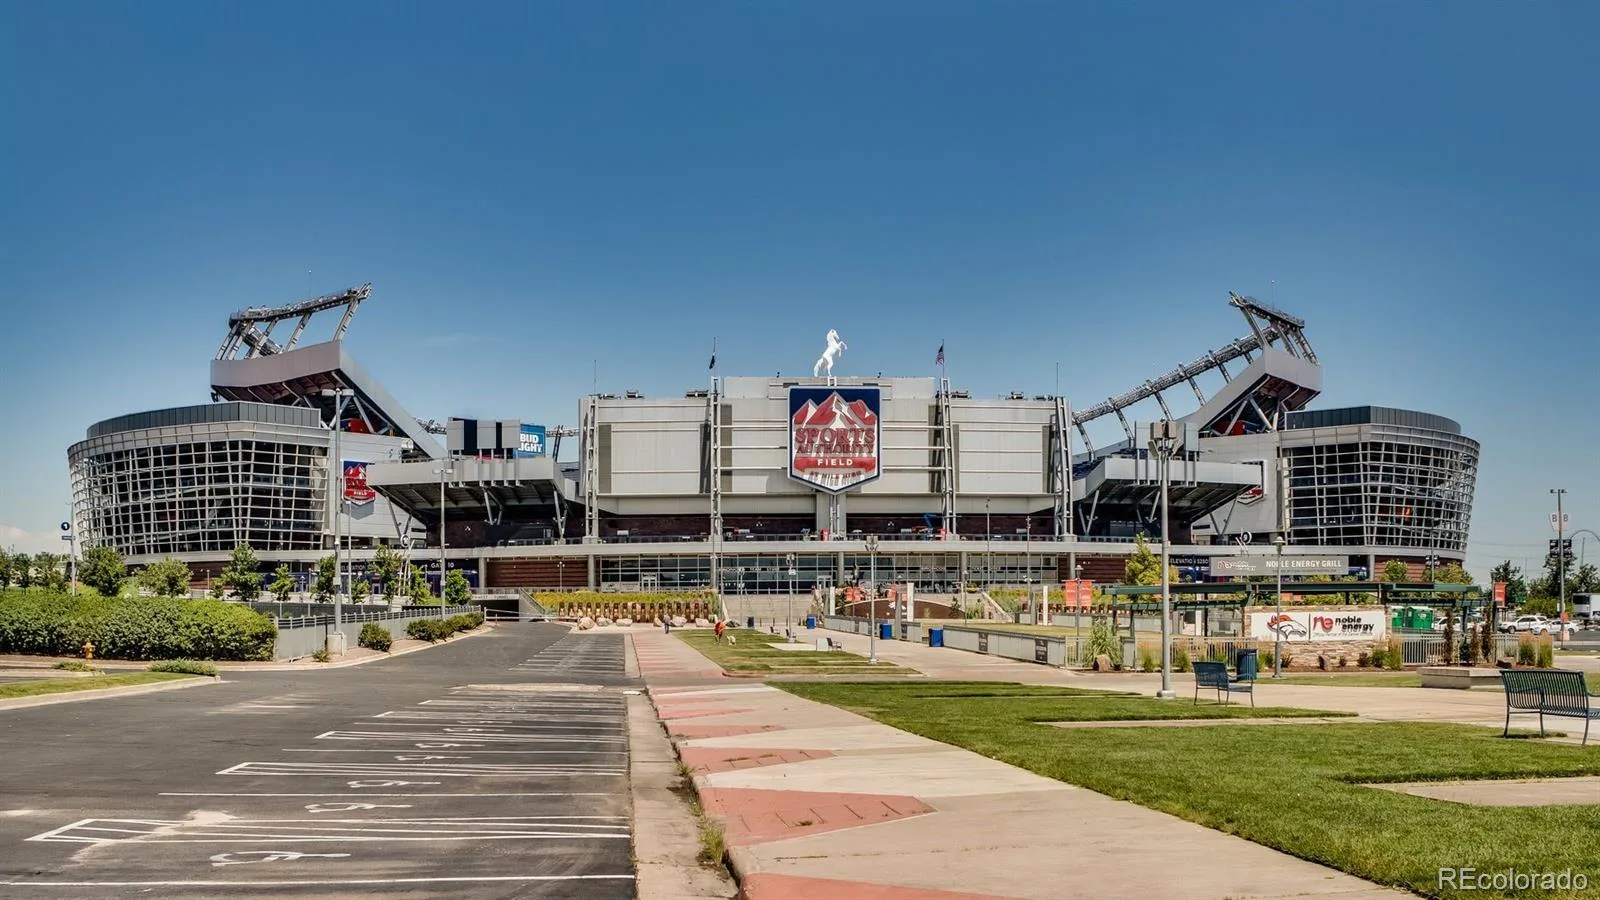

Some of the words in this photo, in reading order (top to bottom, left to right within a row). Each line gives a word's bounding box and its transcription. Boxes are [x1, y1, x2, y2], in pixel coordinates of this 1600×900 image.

[520, 433, 540, 444] BUD
[795, 427, 876, 444] SPORTS
[796, 443, 875, 454] AUTHORITY
[817, 458, 854, 467] FIELD
[1291, 560, 1320, 568] ENERGY
[1321, 560, 1342, 568] GRILL
[1335, 615, 1362, 625] noble
[1342, 624, 1375, 633] energy
